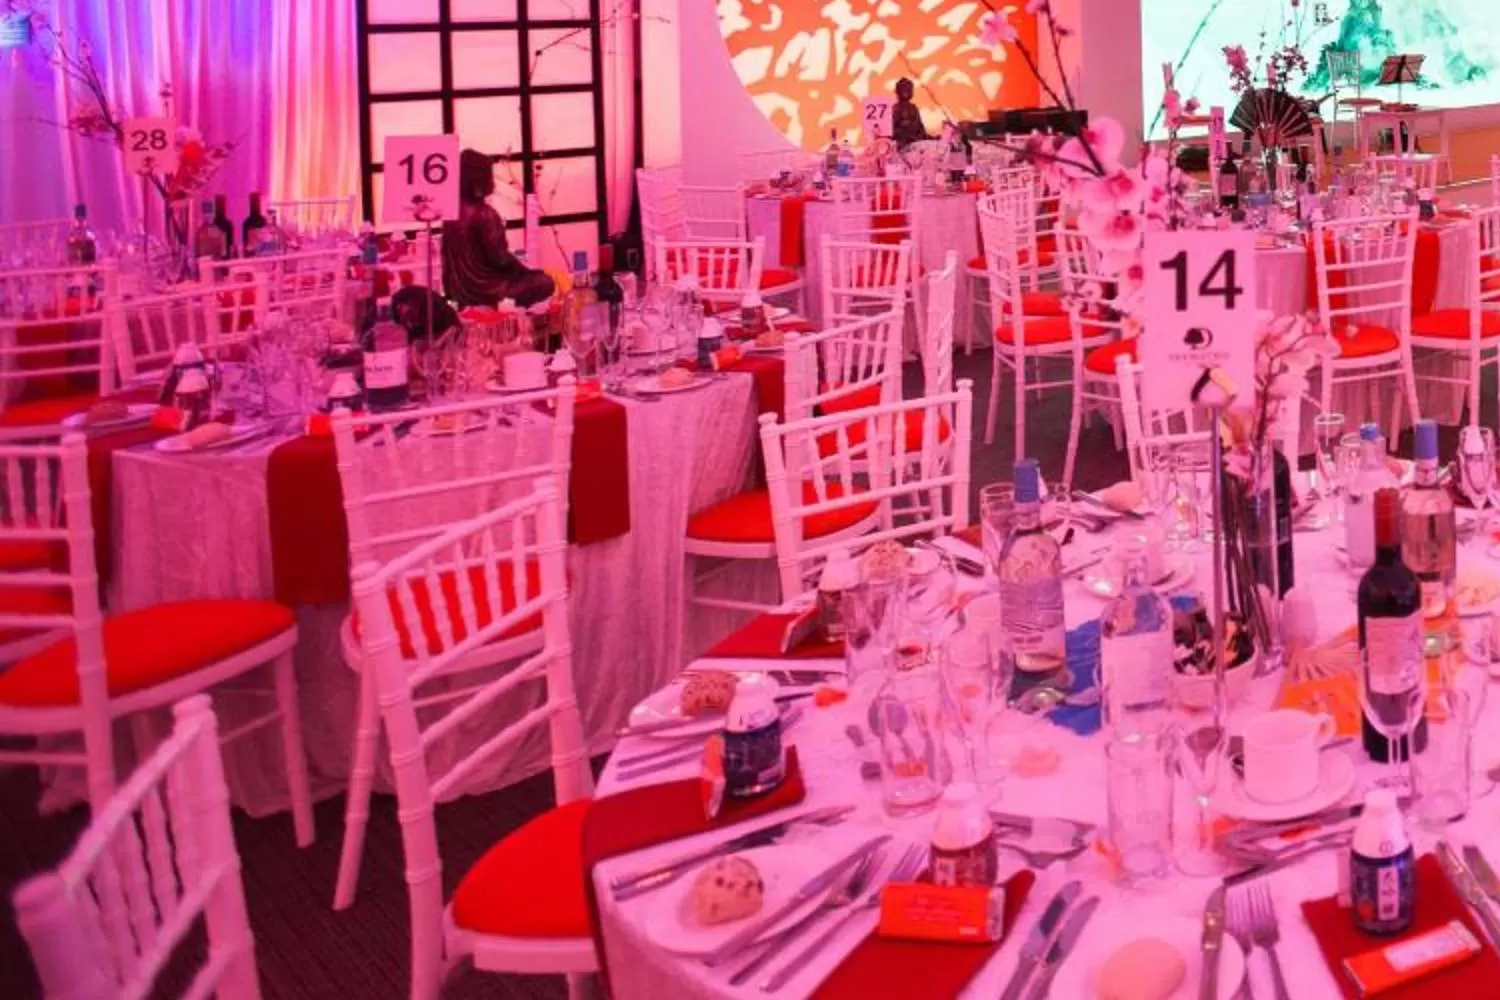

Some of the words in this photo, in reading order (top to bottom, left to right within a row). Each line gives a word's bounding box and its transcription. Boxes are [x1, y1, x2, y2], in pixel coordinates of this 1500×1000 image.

[866, 103, 887, 120] 27
[131, 129, 168, 151] 28
[399, 152, 448, 185] 16
[1159, 249, 1244, 311] 14
